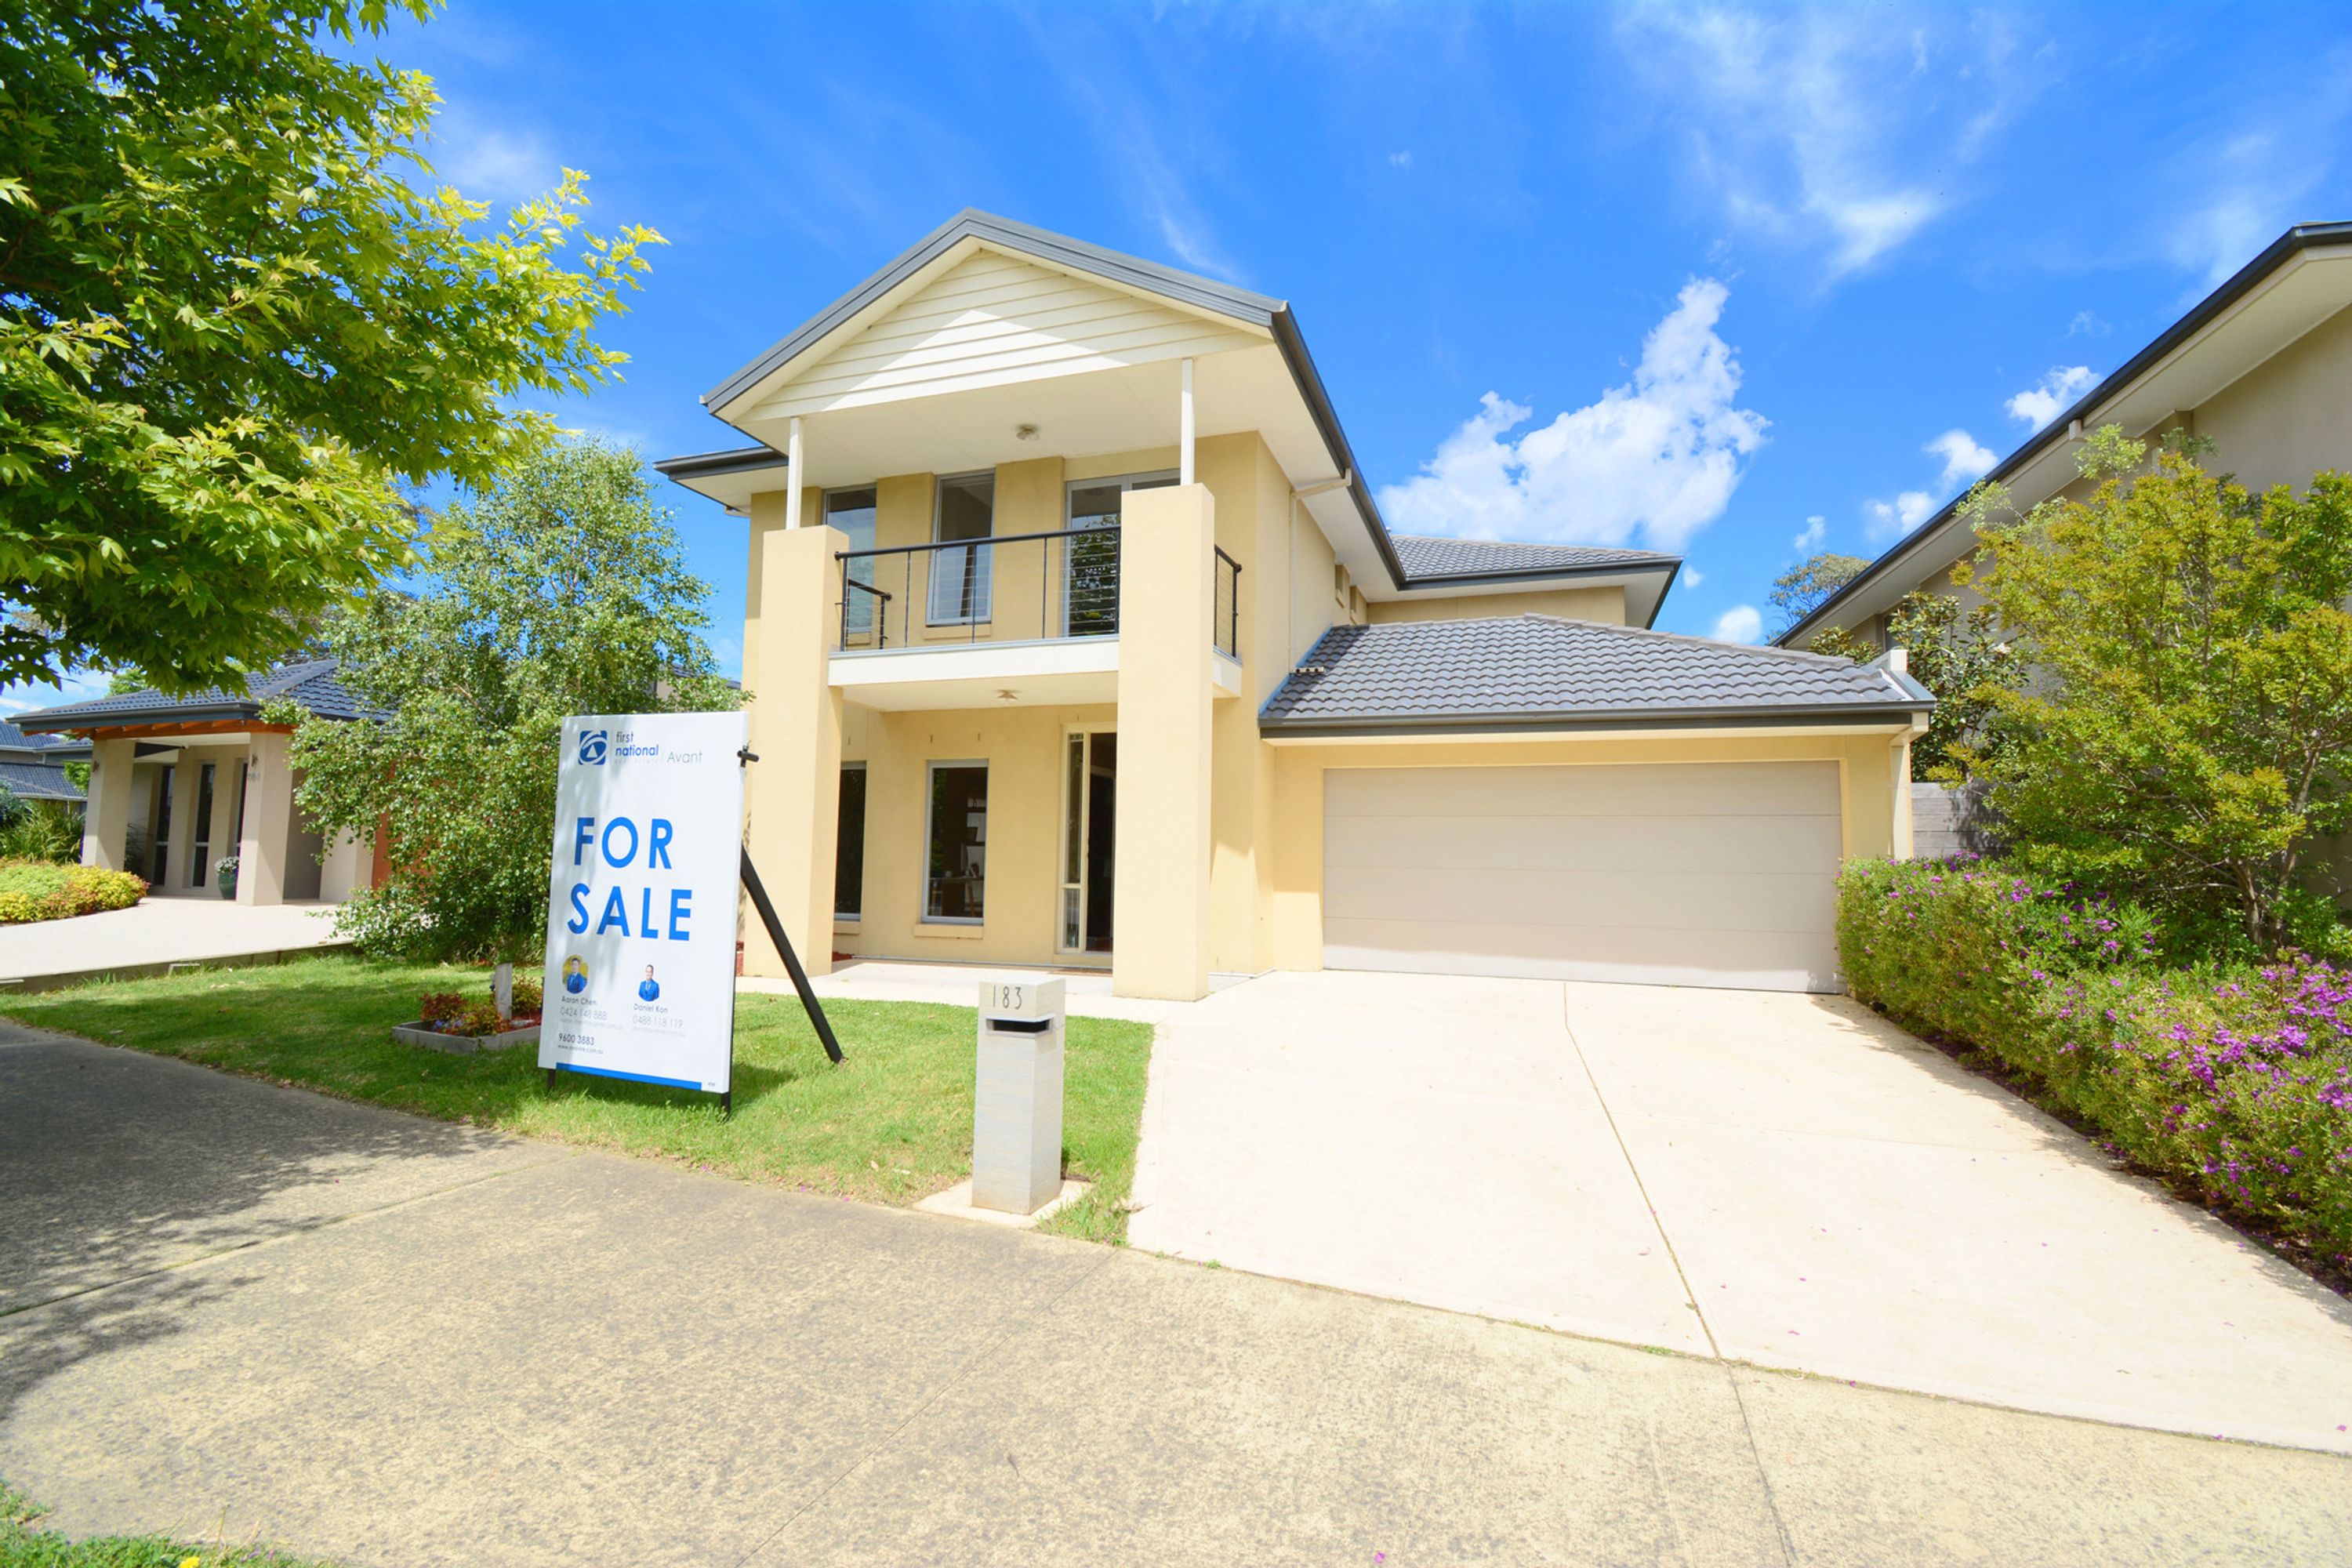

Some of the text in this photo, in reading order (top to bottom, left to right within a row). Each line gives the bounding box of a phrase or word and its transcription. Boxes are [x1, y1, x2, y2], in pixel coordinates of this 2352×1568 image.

[616, 731, 634, 742] first
[615, 745, 659, 757] national
[666, 750, 702, 764] Avant
[575, 816, 673, 869] FOR
[568, 883, 692, 941] SALE
[993, 985, 1022, 1010] 183
